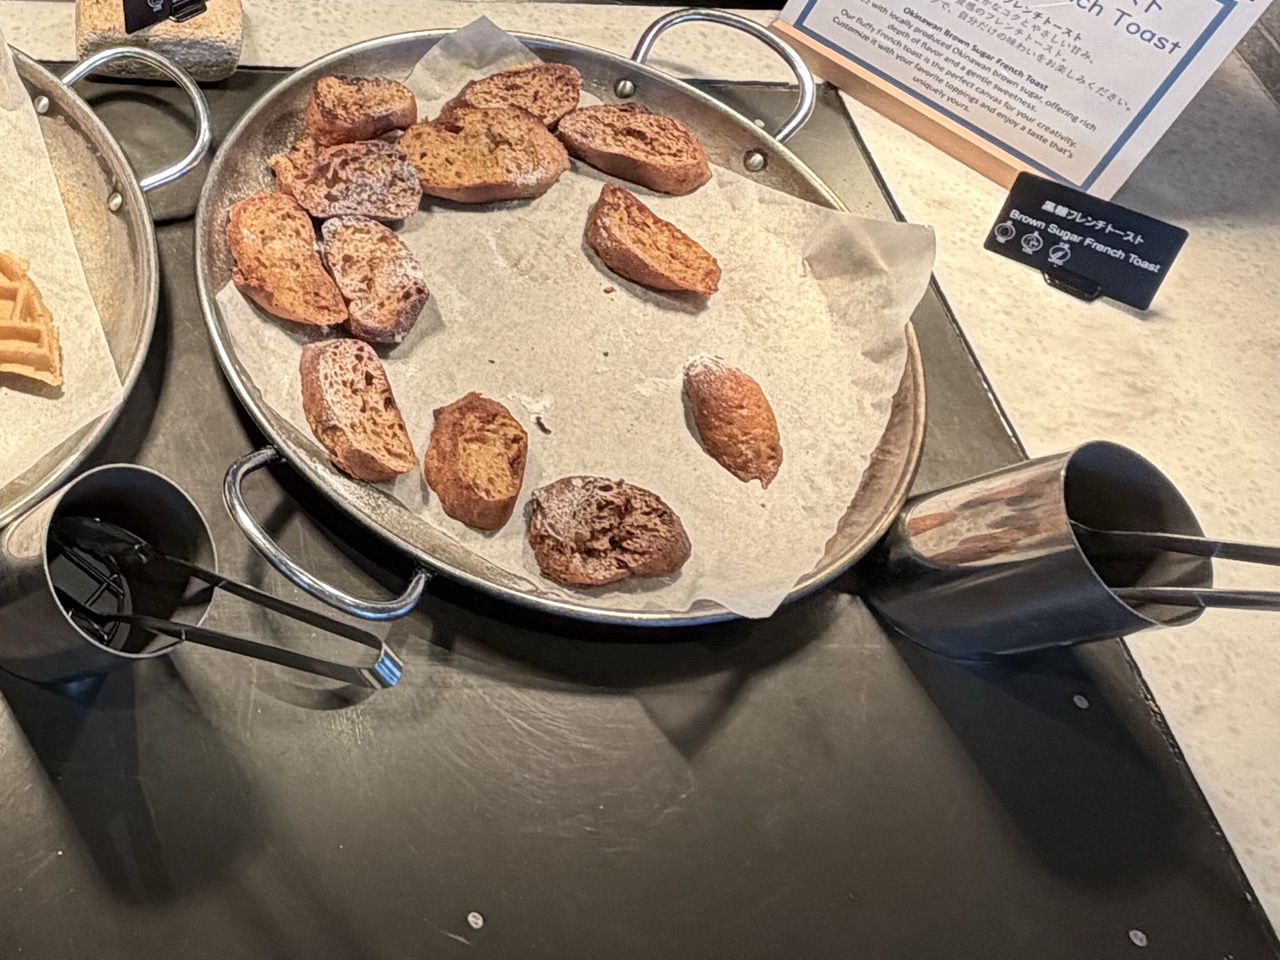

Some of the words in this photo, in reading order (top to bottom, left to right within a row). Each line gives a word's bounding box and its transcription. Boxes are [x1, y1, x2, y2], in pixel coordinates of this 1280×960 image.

[871, 1, 888, 14] with
[888, 10, 913, 29] locally
[912, 26, 952, 50] produced
[951, 46, 991, 72] Okinawan
[991, 68, 1019, 88] brown
[1019, 85, 1043, 103] sugar,
[1044, 100, 1079, 122] offering
[1078, 119, 1096, 132] rich
[886, 23, 910, 39] depth
[920, 41, 943, 57] flavor
[943, 56, 960, 67] and
[965, 69, 992, 86] gentle
[992, 83, 1036, 112] sweetness.
[902, 6, 942, 32] Okinawan
[943, 28, 970, 47] Brown
[970, 44, 995, 60] Sugar
[995, 57, 1024, 78] French
[1025, 74, 1048, 91] Toast
[1113, 7, 1181, 54] Toast
[832, 15, 870, 41] Customize
[877, 42, 894, 55] with
[894, 52, 913, 65] your
[913, 62, 944, 84] favorite
[944, 80, 979, 104] toppings
[979, 101, 997, 113] and
[995, 111, 1020, 128] enjoy
[1026, 128, 1048, 144] taste
[1048, 140, 1073, 158] that's
[840, 8, 855, 20] Our
[855, 16, 875, 32] fluffy
[875, 28, 902, 47] French
[902, 44, 923, 59] toast
[922, 55, 930, 64] is
[930, 60, 945, 72] the
[944, 69, 975, 89] perfect
[974, 86, 1002, 104] canvas
[1002, 100, 1016, 111] for
[1015, 109, 1036, 123] your
[1036, 121, 1076, 148] creativity.
[1009, 209, 1045, 230] Brown
[1047, 224, 1083, 244] Sugar
[1083, 237, 1126, 261] French
[1128, 253, 1162, 273] Toast
[1041, 200, 1145, 245] 黒糖フレンチトースト
